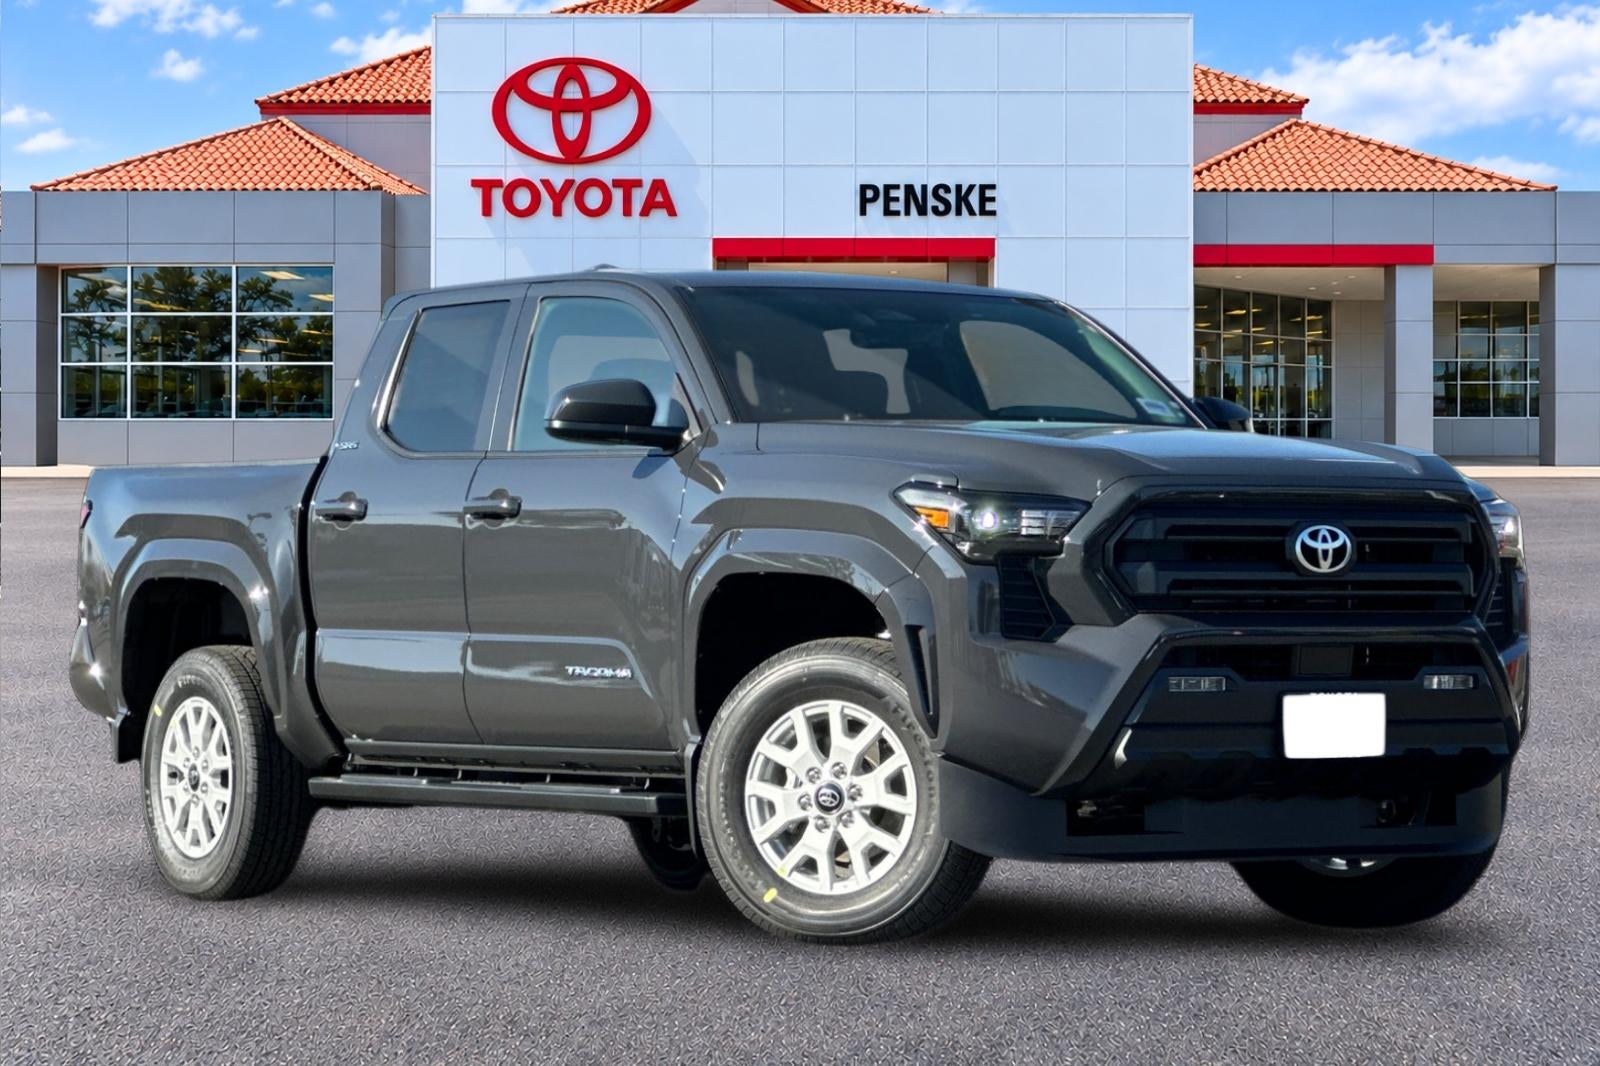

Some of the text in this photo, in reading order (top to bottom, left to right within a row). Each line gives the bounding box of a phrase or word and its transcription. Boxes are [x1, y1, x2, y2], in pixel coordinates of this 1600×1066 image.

[471, 178, 678, 217] TOYOTA
[859, 183, 997, 217] PENSKE
[565, 665, 633, 678] TACOMA
